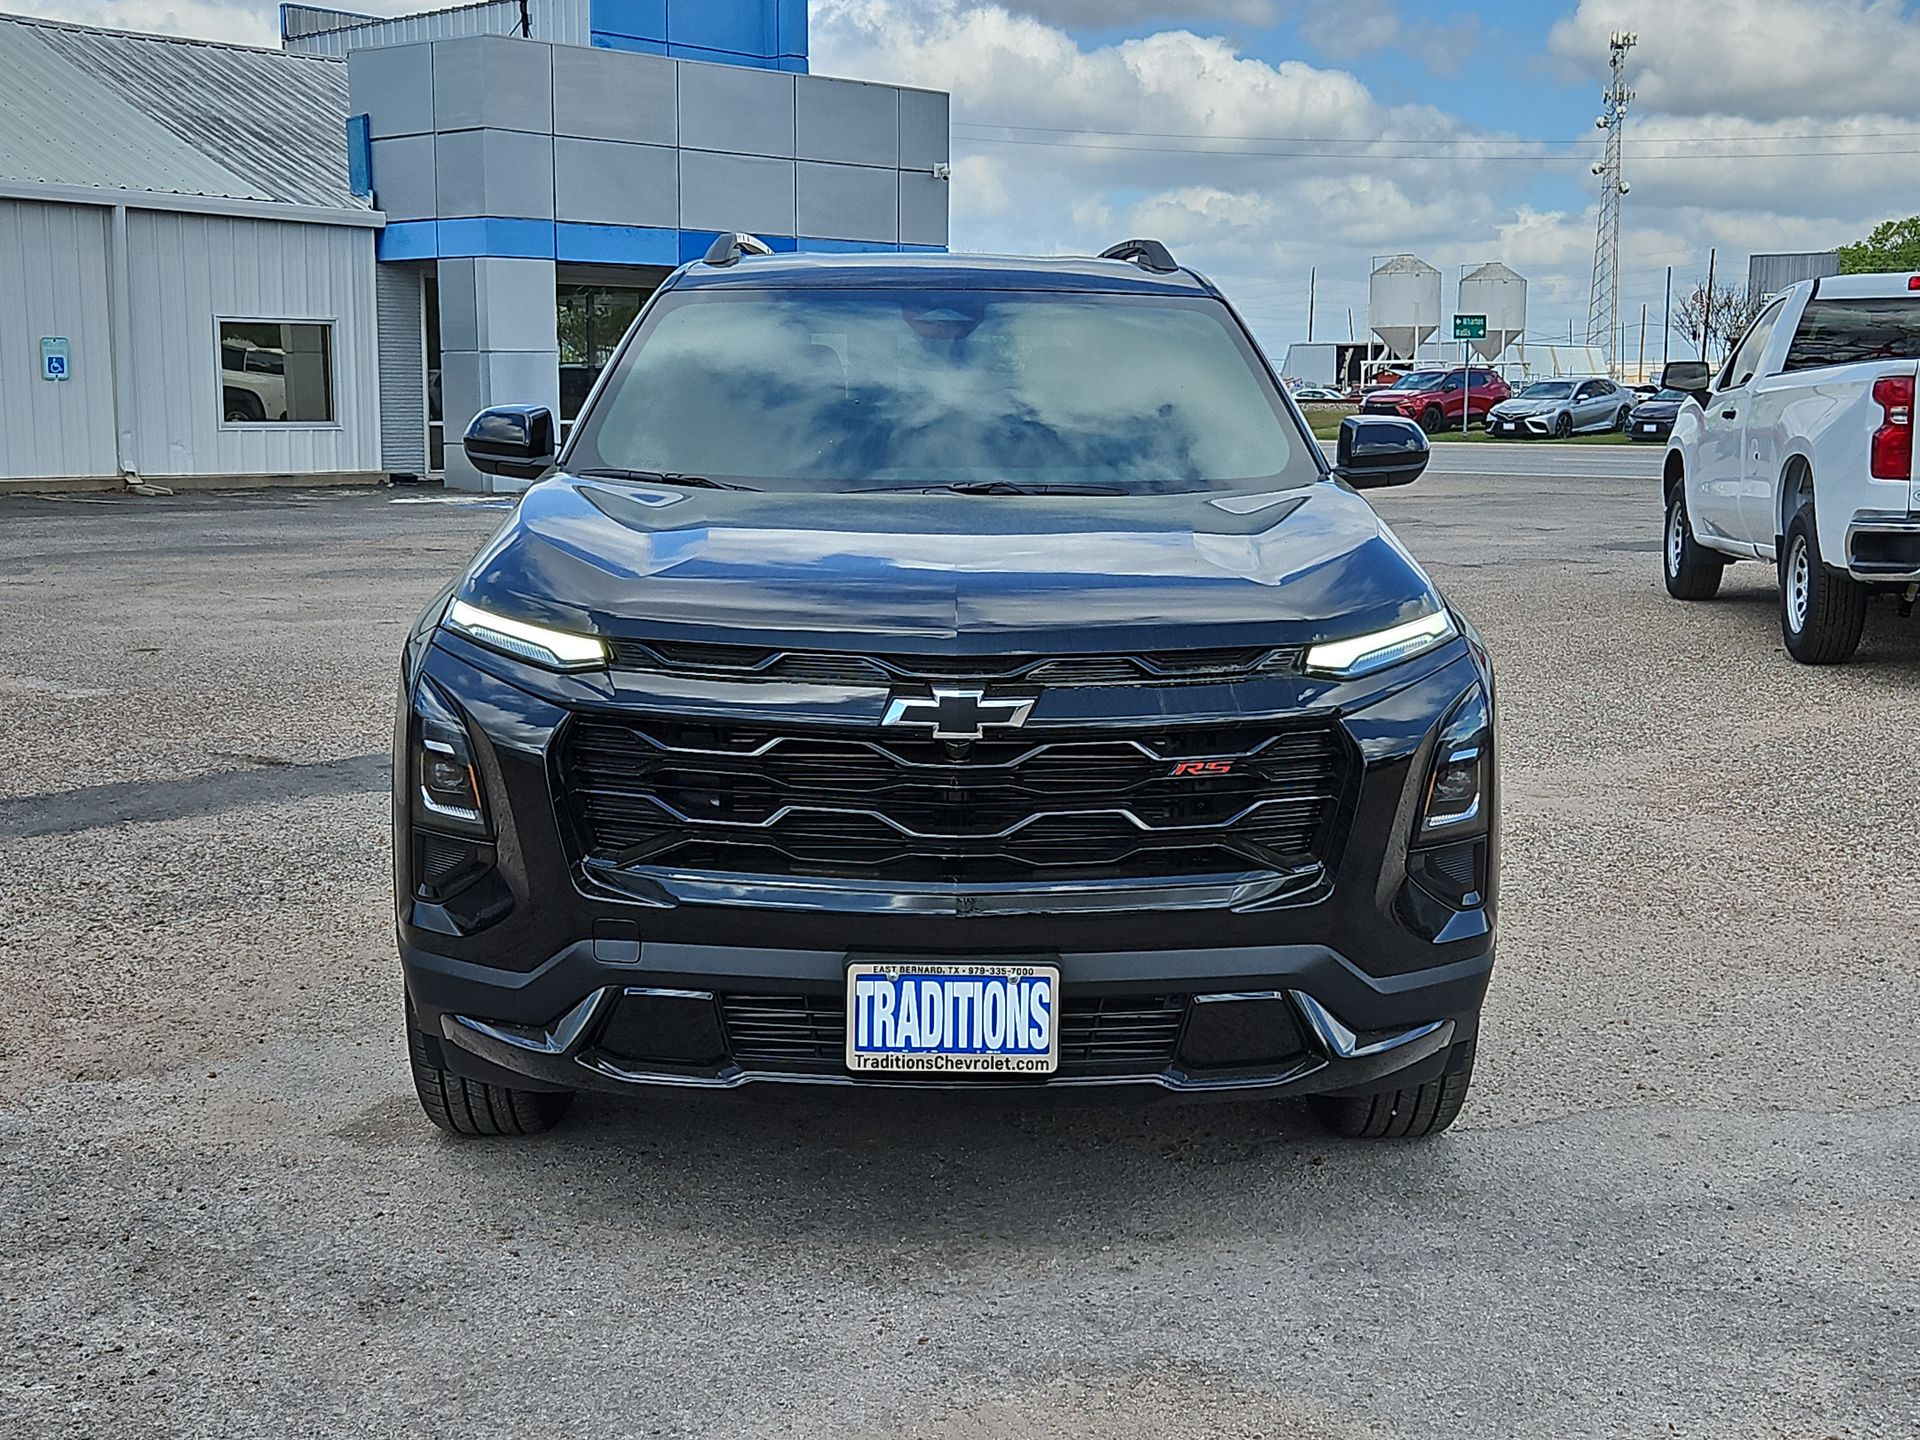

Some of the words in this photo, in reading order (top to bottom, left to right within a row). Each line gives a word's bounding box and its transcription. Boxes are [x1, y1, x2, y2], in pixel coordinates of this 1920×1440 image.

[1175, 761, 1234, 775] RS
[873, 965, 897, 974] EAST
[899, 966, 946, 975] BERNARD,
[948, 966, 960, 975] TX
[968, 966, 1034, 976] 979-335-7000
[856, 980, 1050, 1050] TRADITIONS
[855, 1054, 1050, 1071] TraditionsChevrolet.com
